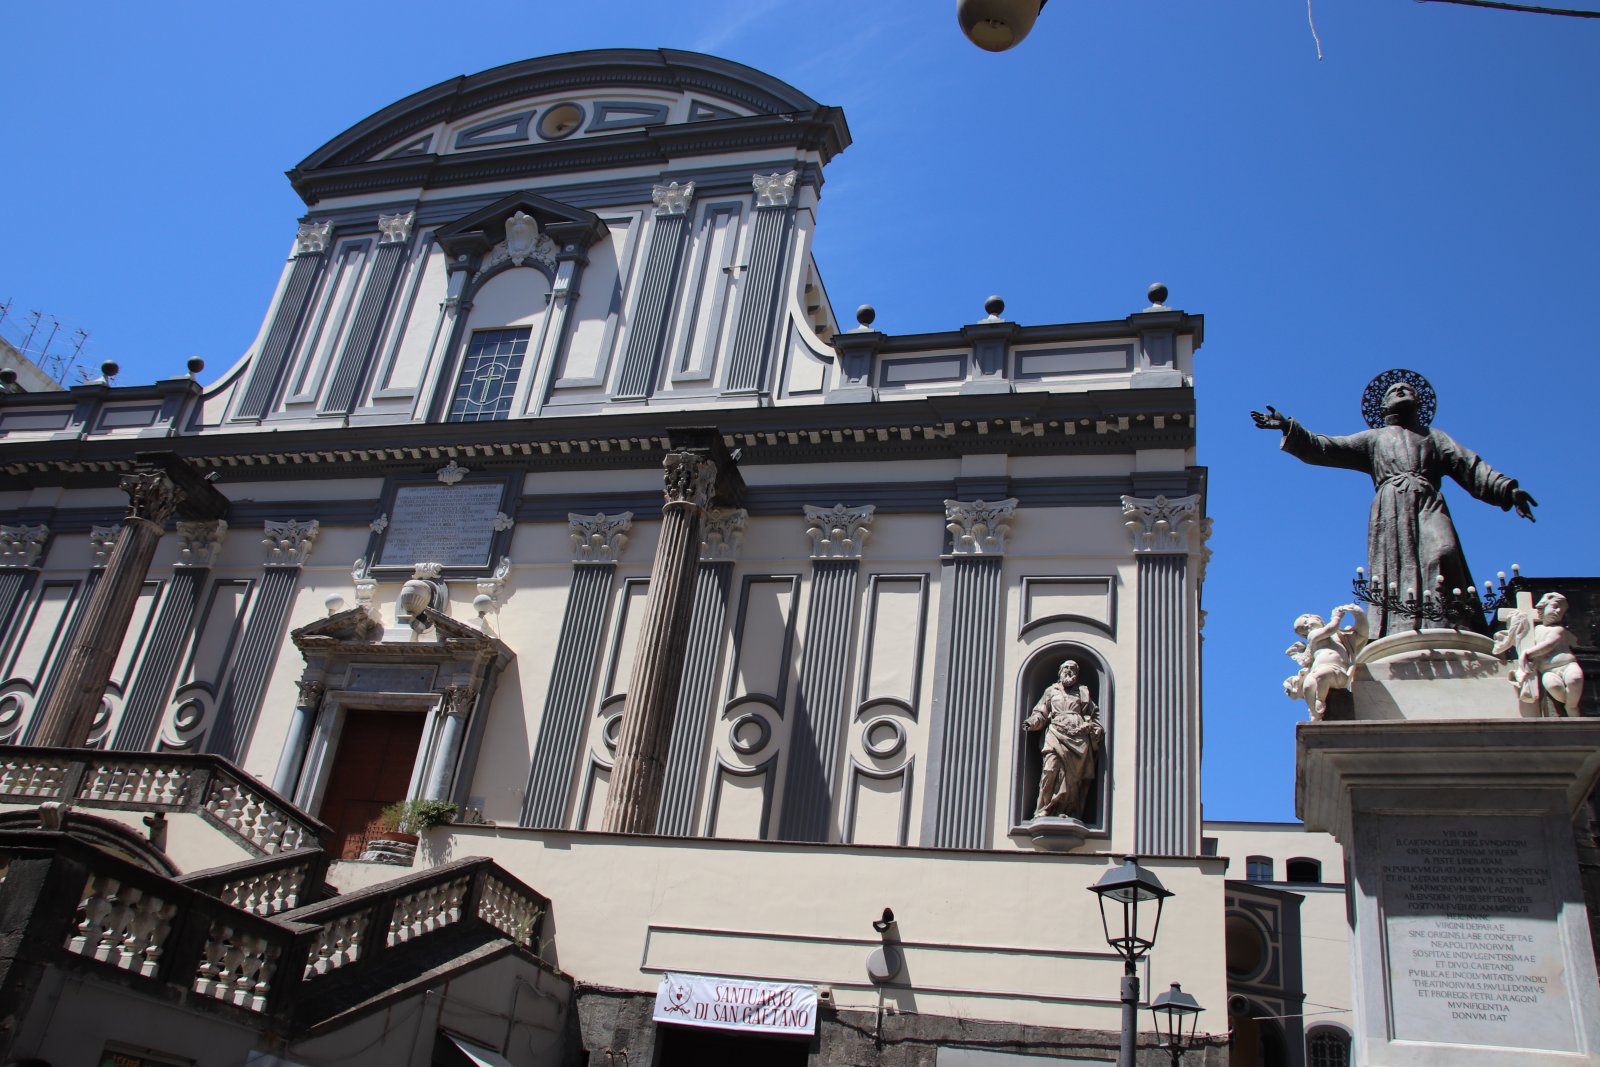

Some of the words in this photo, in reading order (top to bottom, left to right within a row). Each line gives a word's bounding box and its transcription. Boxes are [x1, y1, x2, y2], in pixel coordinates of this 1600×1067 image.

[1484, 933, 1534, 943] CONCEPTAE
[1431, 941, 1514, 951] NEAPOLITANORVM
[1471, 962, 1514, 971] CAIETANO
[1512, 984, 1545, 994] DOMVS
[713, 986, 794, 1008] SANTUARIO
[1447, 1001, 1510, 1012] MVNIFICENTIA
[694, 1002, 709, 1020] DI
[713, 1004, 739, 1023] SAN
[742, 1007, 809, 1028] GAETANO
[1452, 1011, 1487, 1021] DONVM
[1489, 1013, 1508, 1022] DAT
